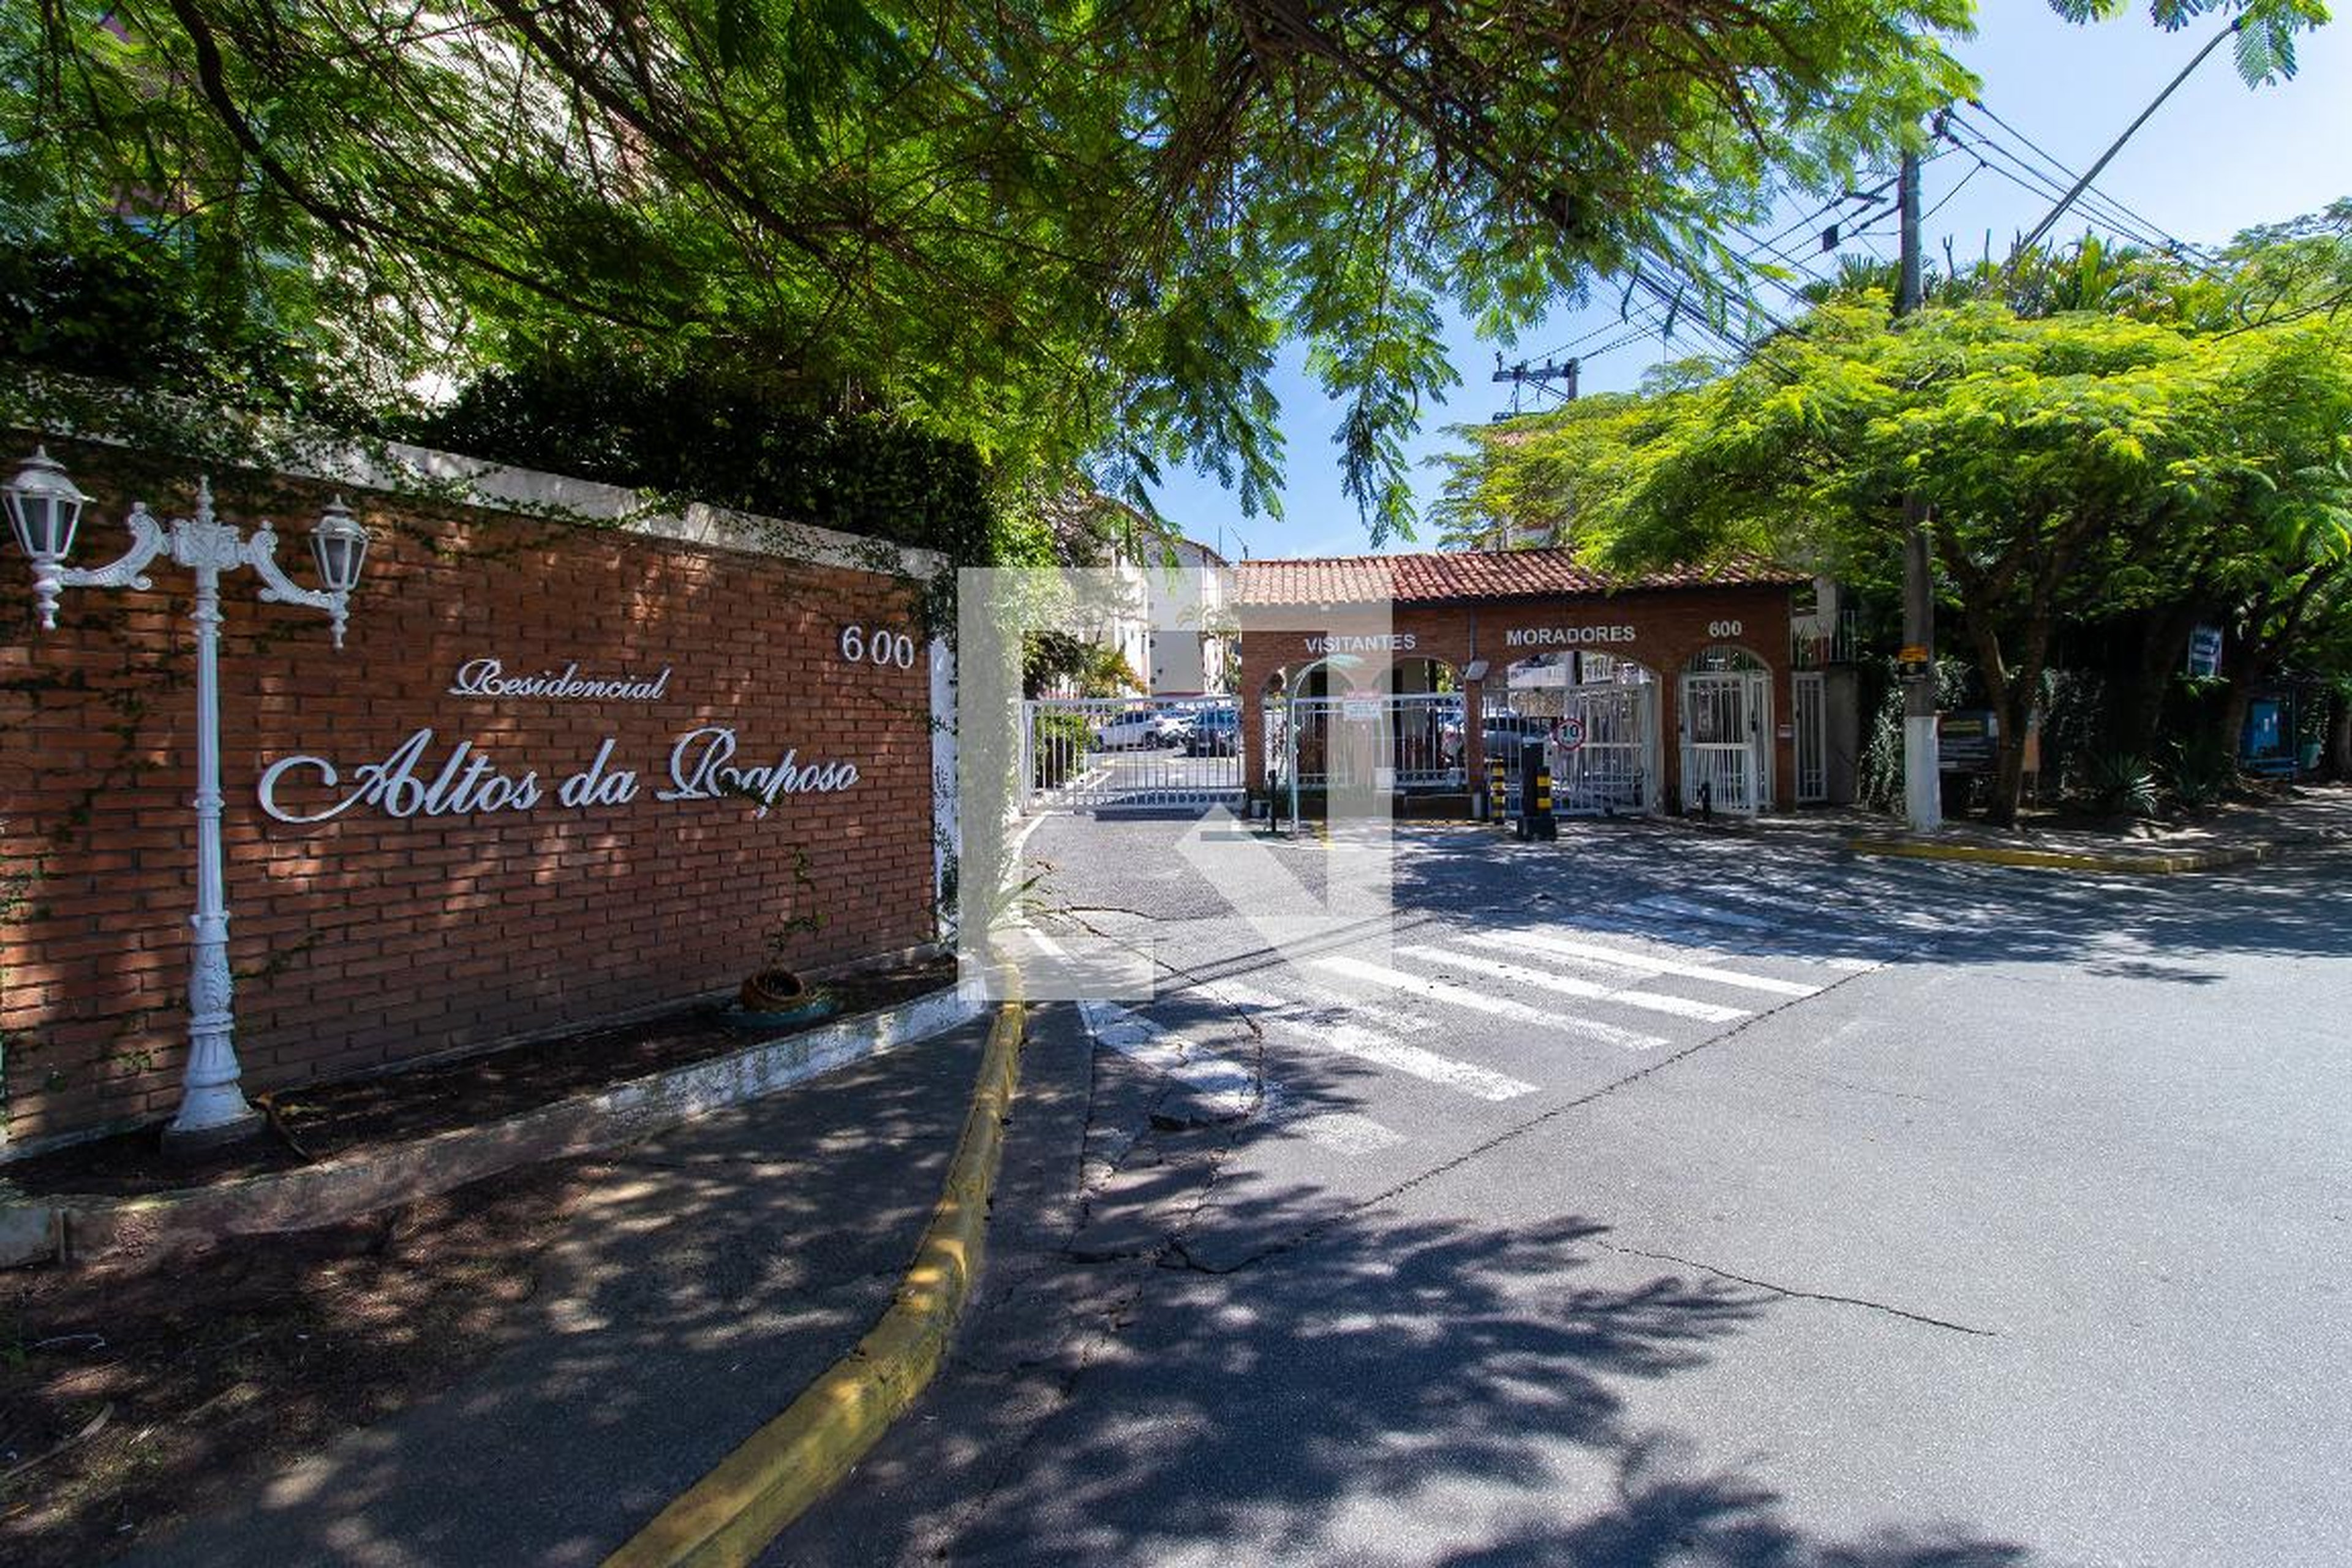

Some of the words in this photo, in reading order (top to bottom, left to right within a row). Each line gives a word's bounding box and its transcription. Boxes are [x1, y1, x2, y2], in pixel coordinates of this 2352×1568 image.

[1506, 625, 1635, 646] MORADORES
[1709, 620, 1742, 638] 600
[842, 625, 914, 669] 600
[1304, 633, 1416, 653] VISITANTES
[446, 658, 671, 699] Residencial
[1562, 725, 1579, 737] 10
[258, 728, 543, 823] Altos
[559, 738, 640, 807] da
[657, 727, 860, 820] Raposo
